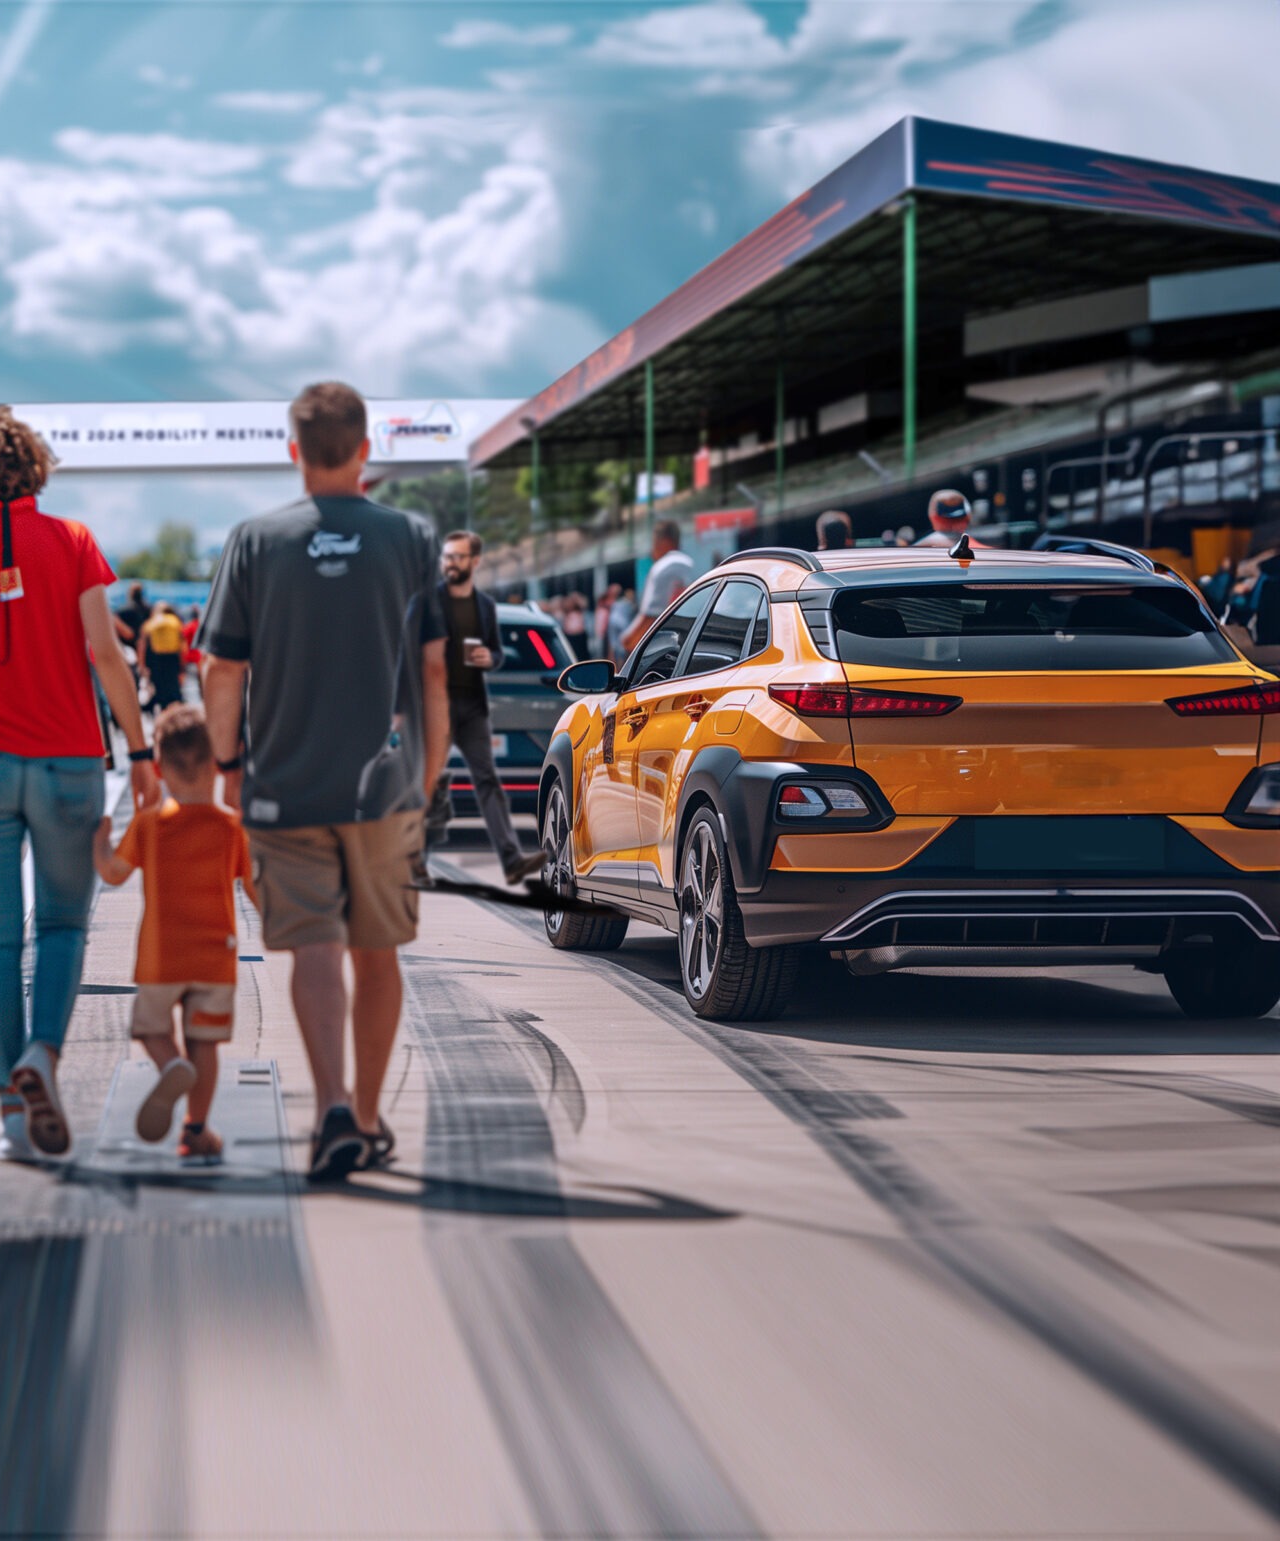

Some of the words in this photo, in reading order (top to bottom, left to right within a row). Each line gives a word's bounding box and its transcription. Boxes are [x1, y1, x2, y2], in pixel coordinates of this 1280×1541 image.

[51, 430, 79, 440] THE
[87, 430, 125, 441] 2024
[133, 429, 208, 440] MOBILITY
[216, 429, 285, 440] MEETING
